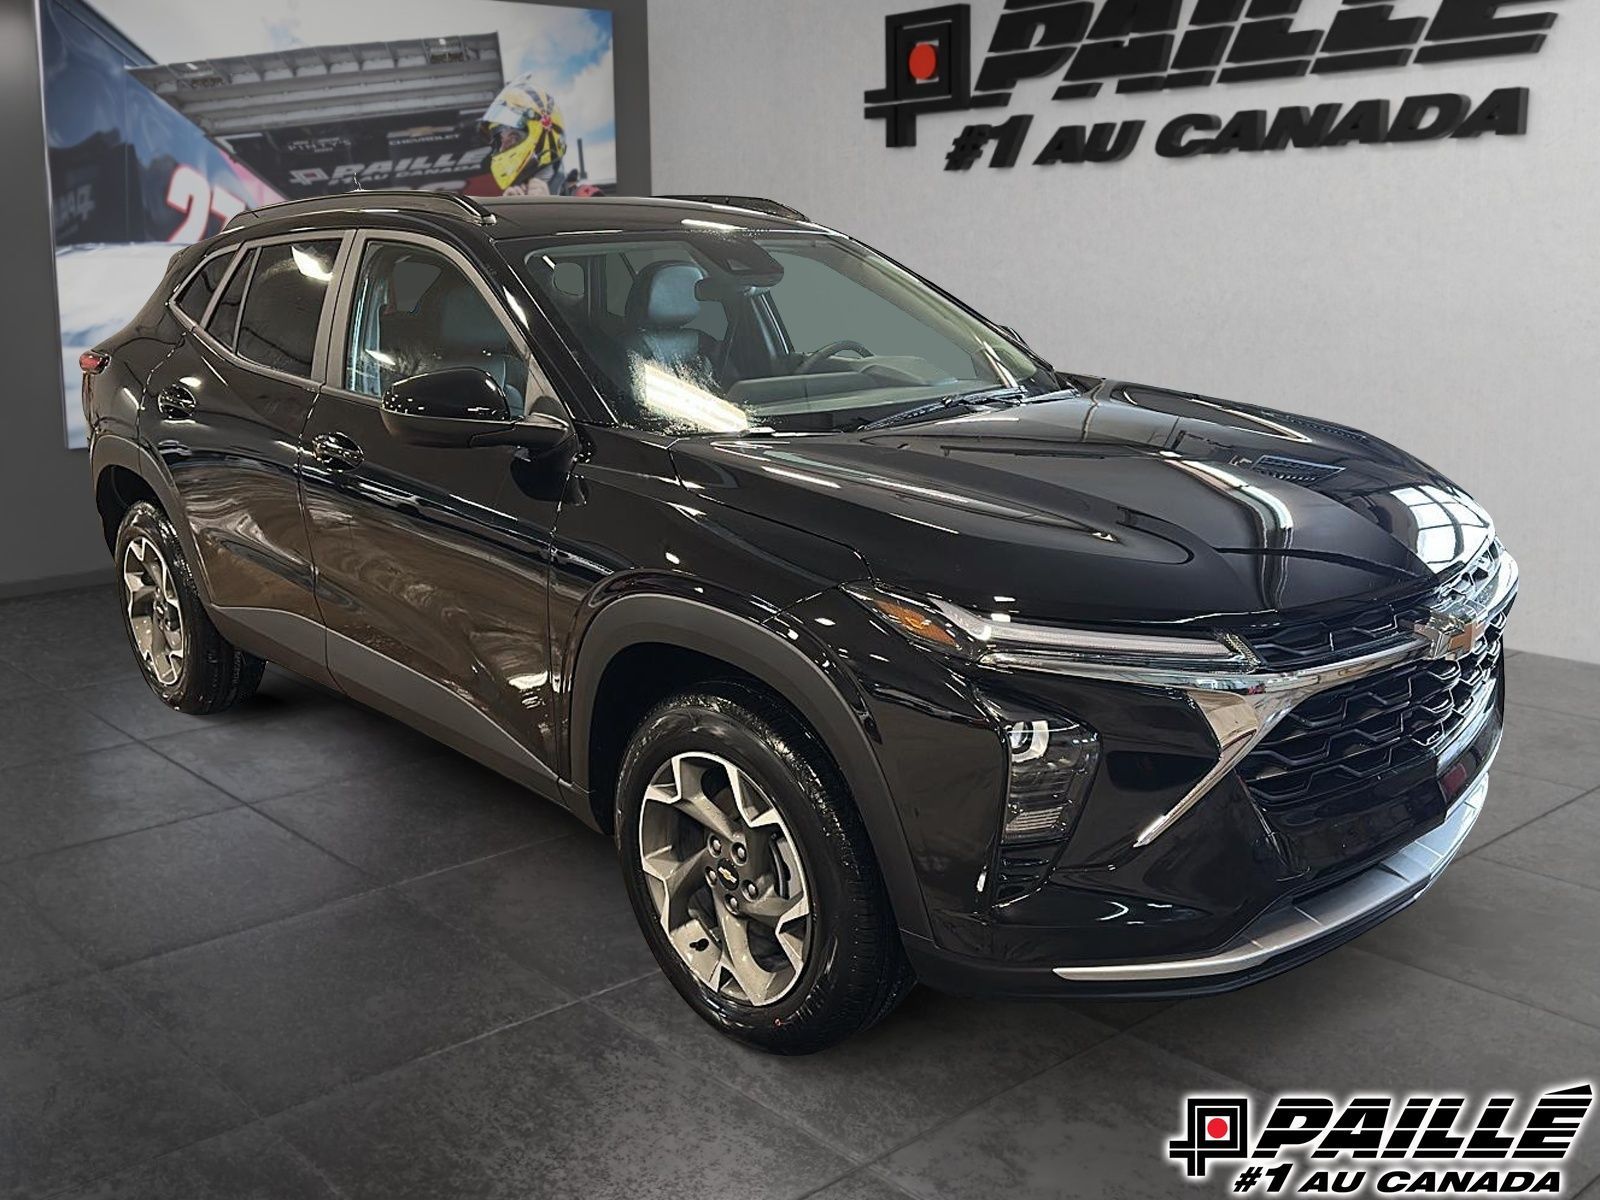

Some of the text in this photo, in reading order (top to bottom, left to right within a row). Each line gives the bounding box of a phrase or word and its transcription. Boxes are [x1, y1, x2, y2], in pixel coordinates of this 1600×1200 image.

[944, 87, 1530, 171] #1 AU CANADA
[395, 164, 482, 179] CANADA
